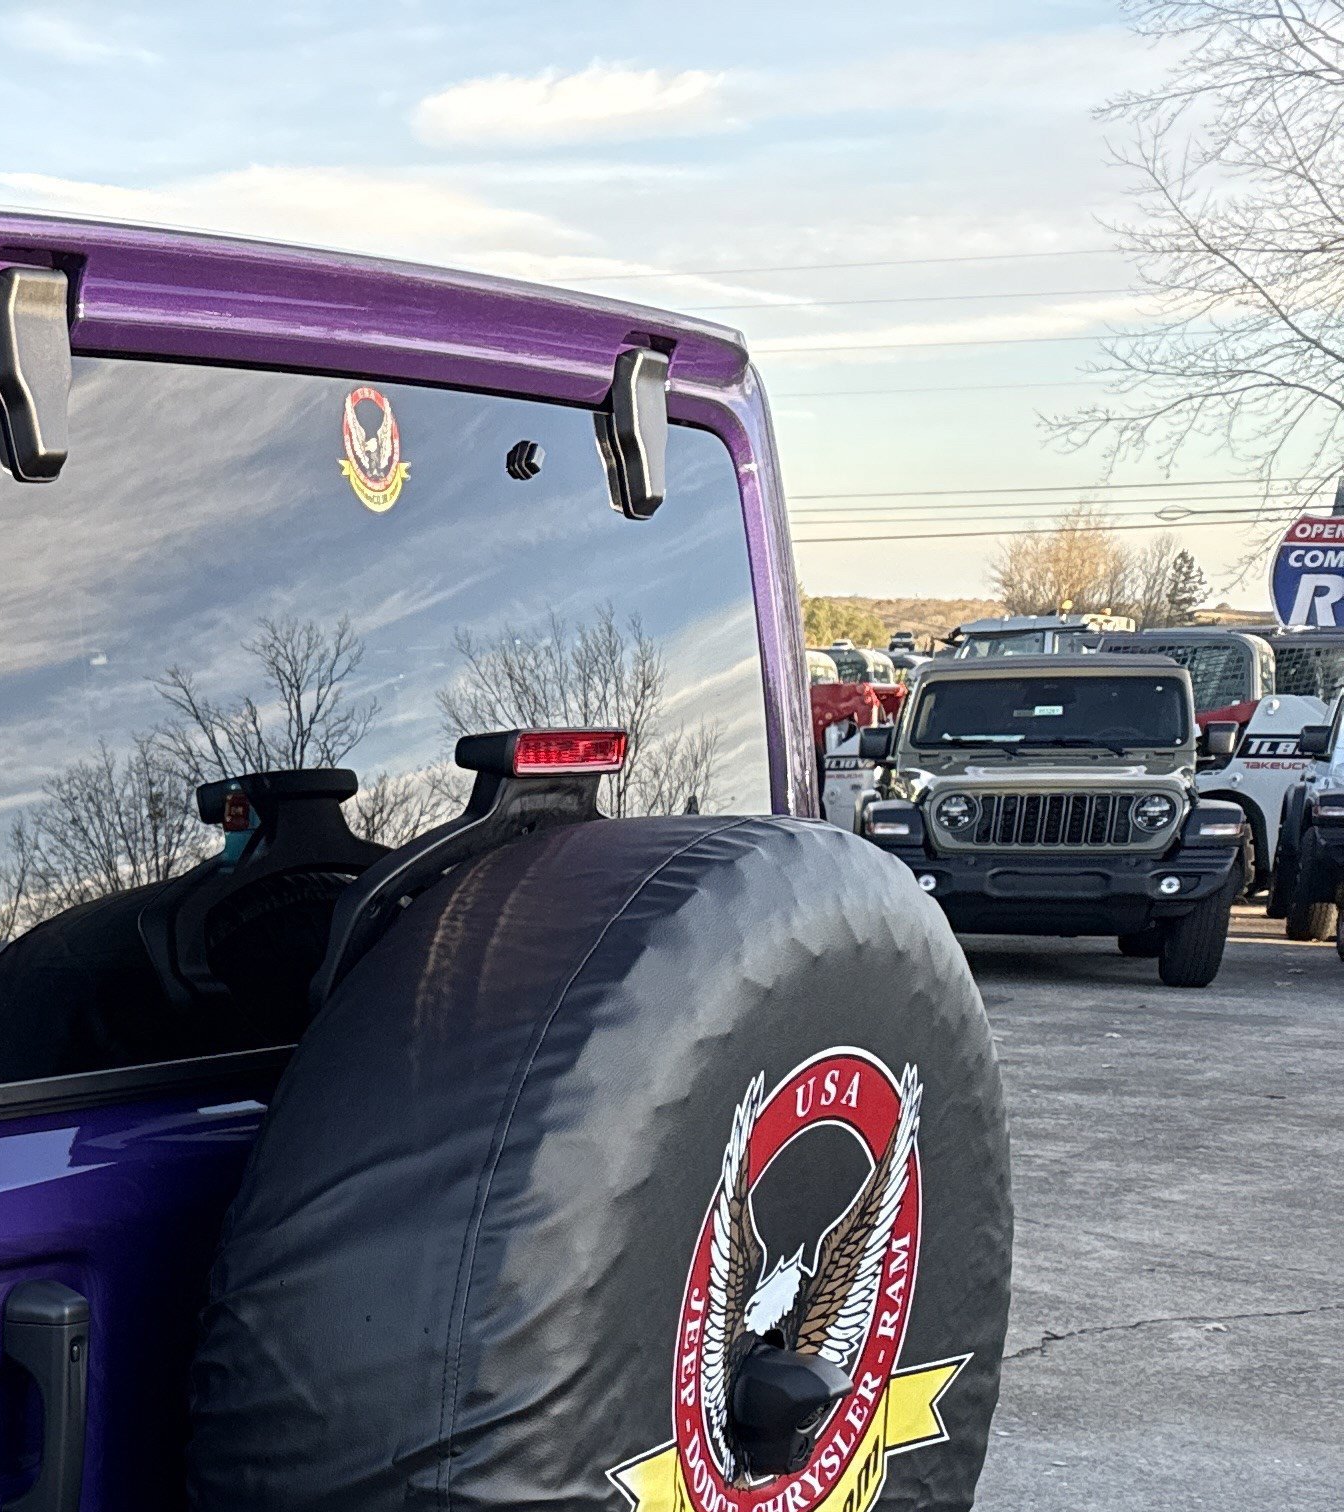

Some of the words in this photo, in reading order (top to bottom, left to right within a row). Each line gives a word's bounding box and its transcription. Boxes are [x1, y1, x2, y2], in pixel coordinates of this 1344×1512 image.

[796, 1069, 861, 1118] USA
[680, 1287, 705, 1406] JEEP
[876, 1231, 911, 1341] RAM
